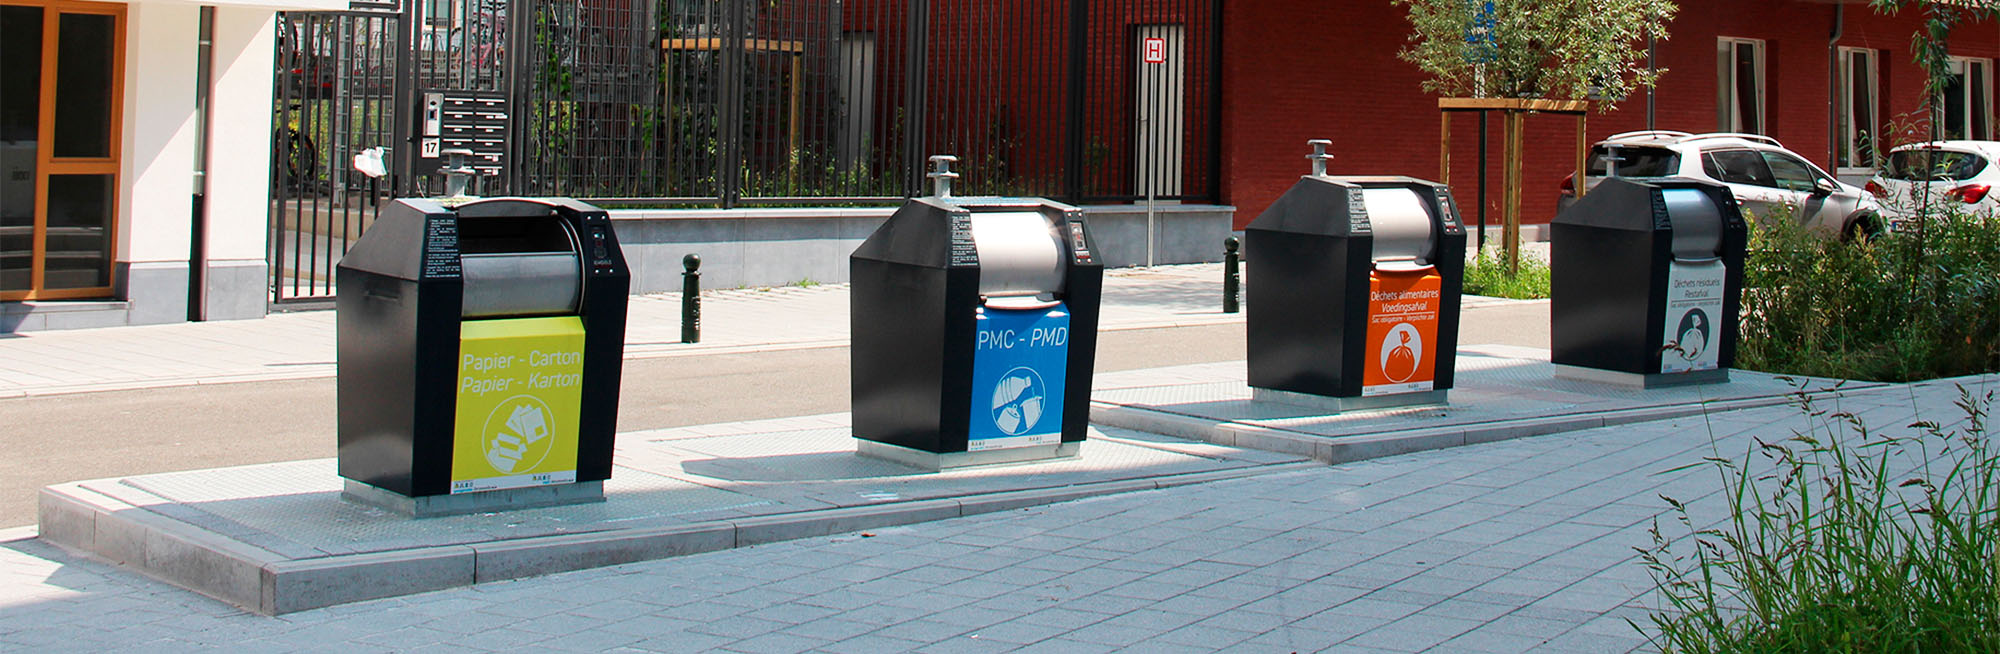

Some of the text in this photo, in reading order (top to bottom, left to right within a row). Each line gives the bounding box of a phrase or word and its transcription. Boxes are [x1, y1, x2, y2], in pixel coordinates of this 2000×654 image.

[1149, 43, 1160, 58] H
[425, 142, 437, 153] 17
[1371, 289, 1439, 301] Déchets alimentaires
[1382, 301, 1428, 313] Voedingsafval
[978, 329, 1015, 350] PMC
[1030, 327, 1067, 347] PMD
[463, 353, 515, 373] Papier
[529, 350, 580, 367] Carton
[461, 375, 514, 396] Papier
[528, 372, 580, 389] Karton
